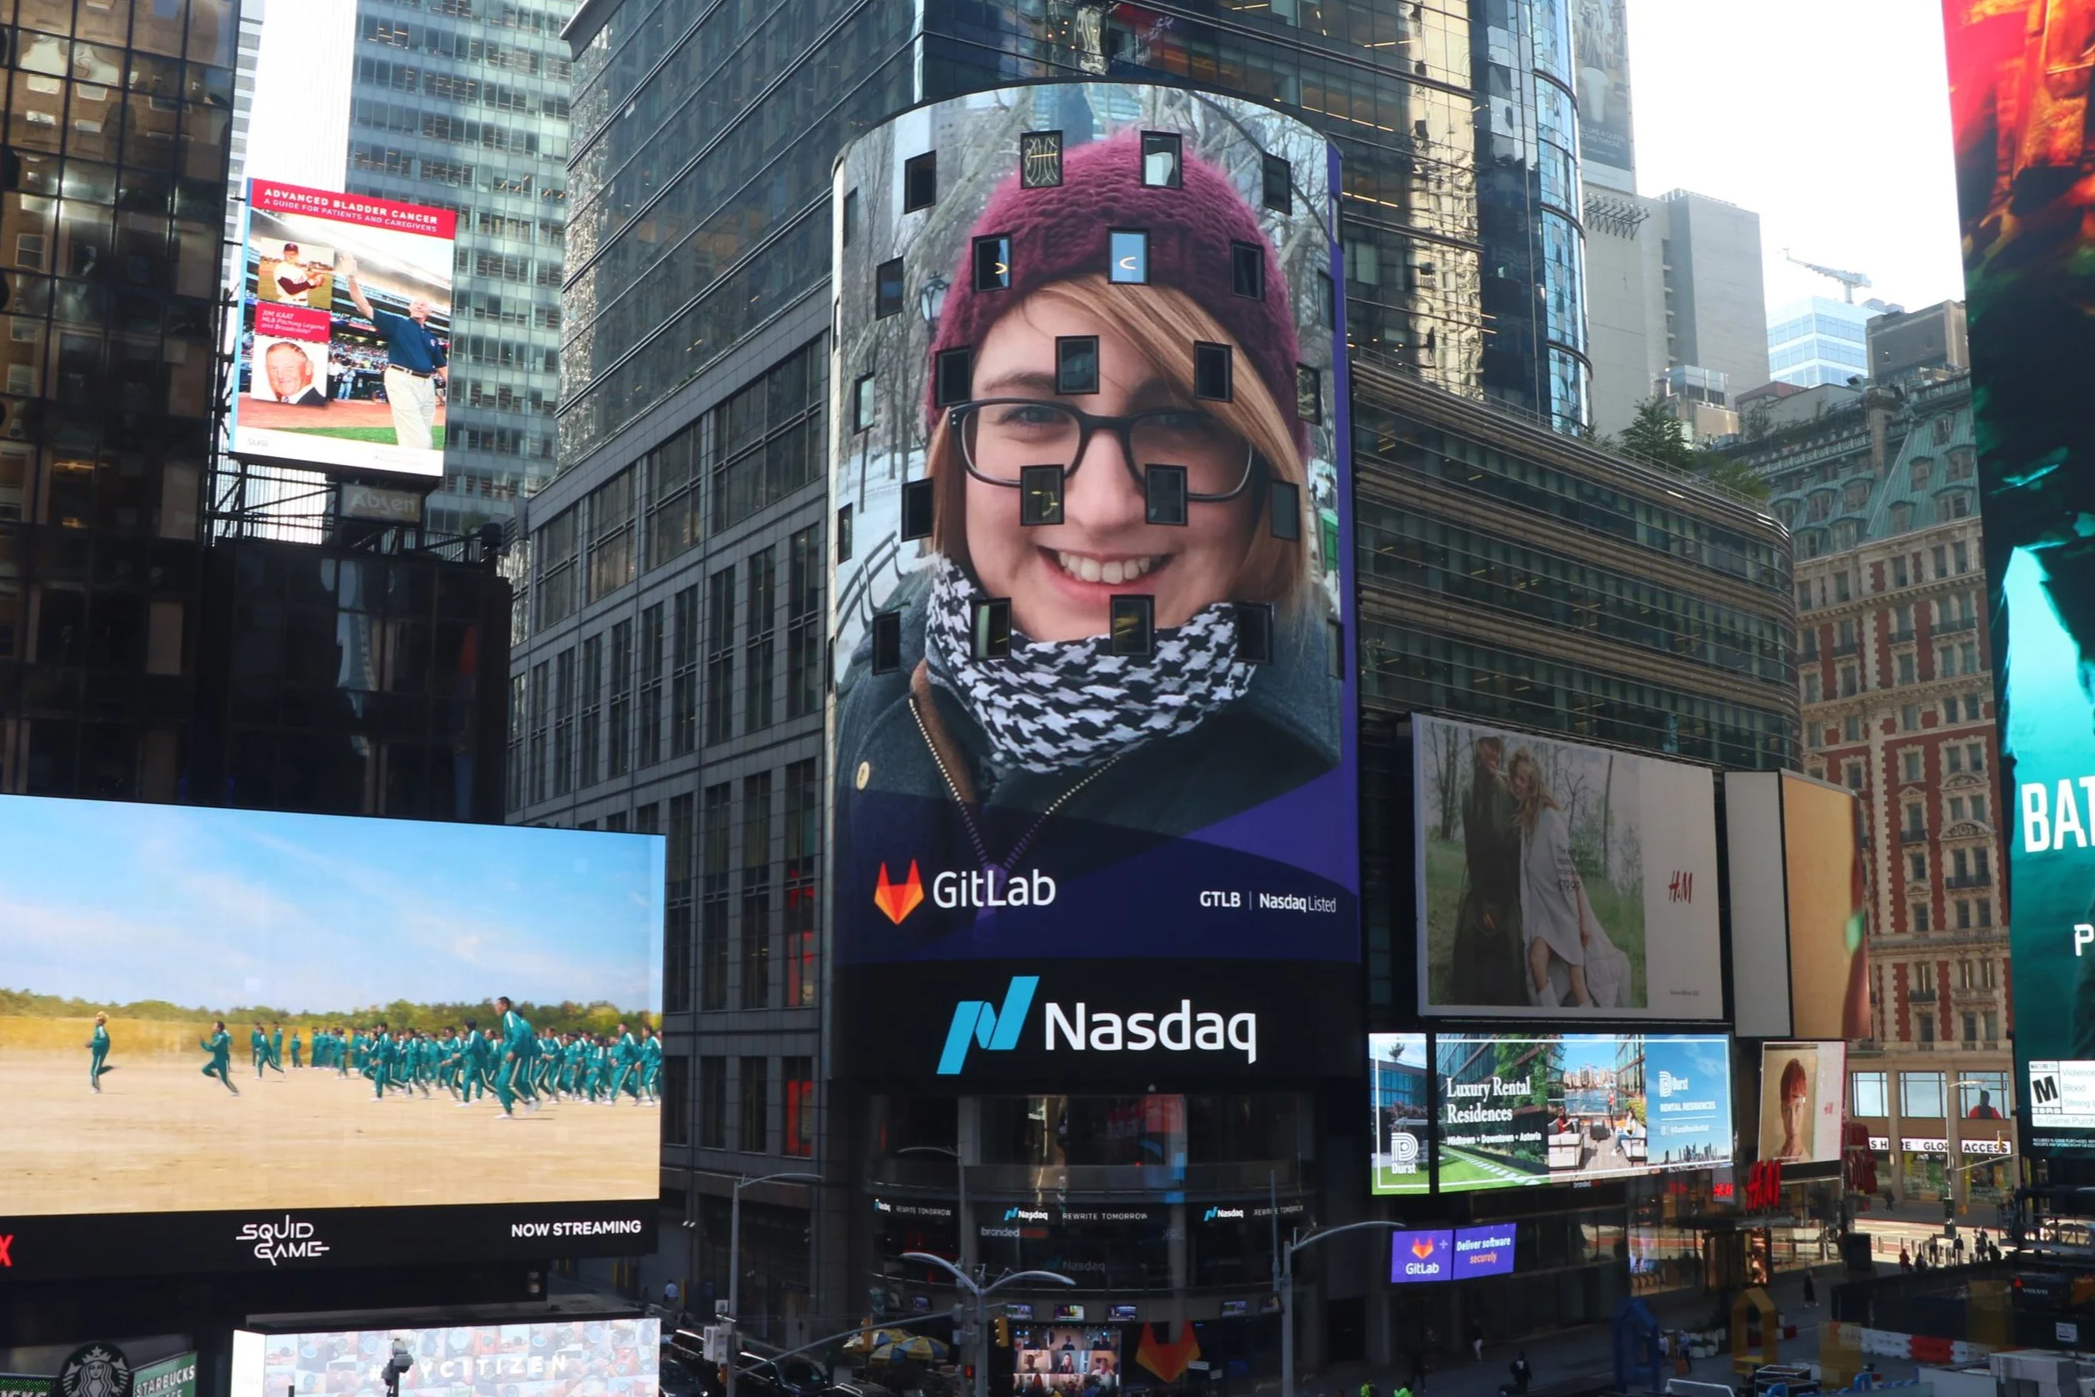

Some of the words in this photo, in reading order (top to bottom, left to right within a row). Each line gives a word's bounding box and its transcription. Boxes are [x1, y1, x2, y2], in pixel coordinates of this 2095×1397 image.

[264, 188, 329, 206] ADVANCED
[333, 200, 387, 216] BLADDER
[392, 210, 438, 224] CANCER
[273, 200, 299, 210] GUIDE
[302, 204, 319, 213] FOR
[322, 207, 362, 221] PATIENTS
[365, 215, 383, 224] AND
[385, 218, 437, 233] CAREGIVERS
[933, 868, 1056, 908] GitLab
[1200, 890, 1241, 907] GTLB
[1259, 893, 1307, 913] Nasdaq
[1308, 896, 1337, 913] Listed
[1045, 999, 1257, 1064] Nasdaq
[1446, 1077, 1490, 1102] Luxury
[1493, 1076, 1531, 1096] Rental
[2032, 1075, 2059, 1104] M
[2063, 1083, 2086, 1092] Blood
[1447, 1103, 1513, 1123] Residences
[1660, 1102, 1682, 1112] RENTAL
[1447, 1135, 1475, 1146] Midtown
[1481, 1133, 1514, 1144] Downtown
[1519, 1131, 1542, 1142] Astoria
[1391, 1163, 1416, 1175] Durst
[918, 1207, 952, 1216] TOMORROW
[1018, 1210, 1049, 1222] Nasdaq
[1062, 1213, 1098, 1221] REWRITE
[1217, 1208, 1244, 1219] Nasdaq
[235, 1214, 315, 1243] SQUID
[511, 1223, 550, 1238] NOW
[552, 1220, 642, 1236] STREAMING
[981, 1226, 1020, 1238] branded
[1456, 1239, 1481, 1251] Deliver
[1482, 1236, 1511, 1249] software
[254, 1241, 330, 1266] GAME
[1470, 1251, 1498, 1264] securely
[1062, 1260, 1106, 1274] Nasdaq
[1405, 1262, 1440, 1275] GitLab
[2022, 1287, 2049, 1295] VOLVO
[368, 1354, 569, 1382] #YCITIZEN
[136, 1364, 195, 1396] STARBUCKS
